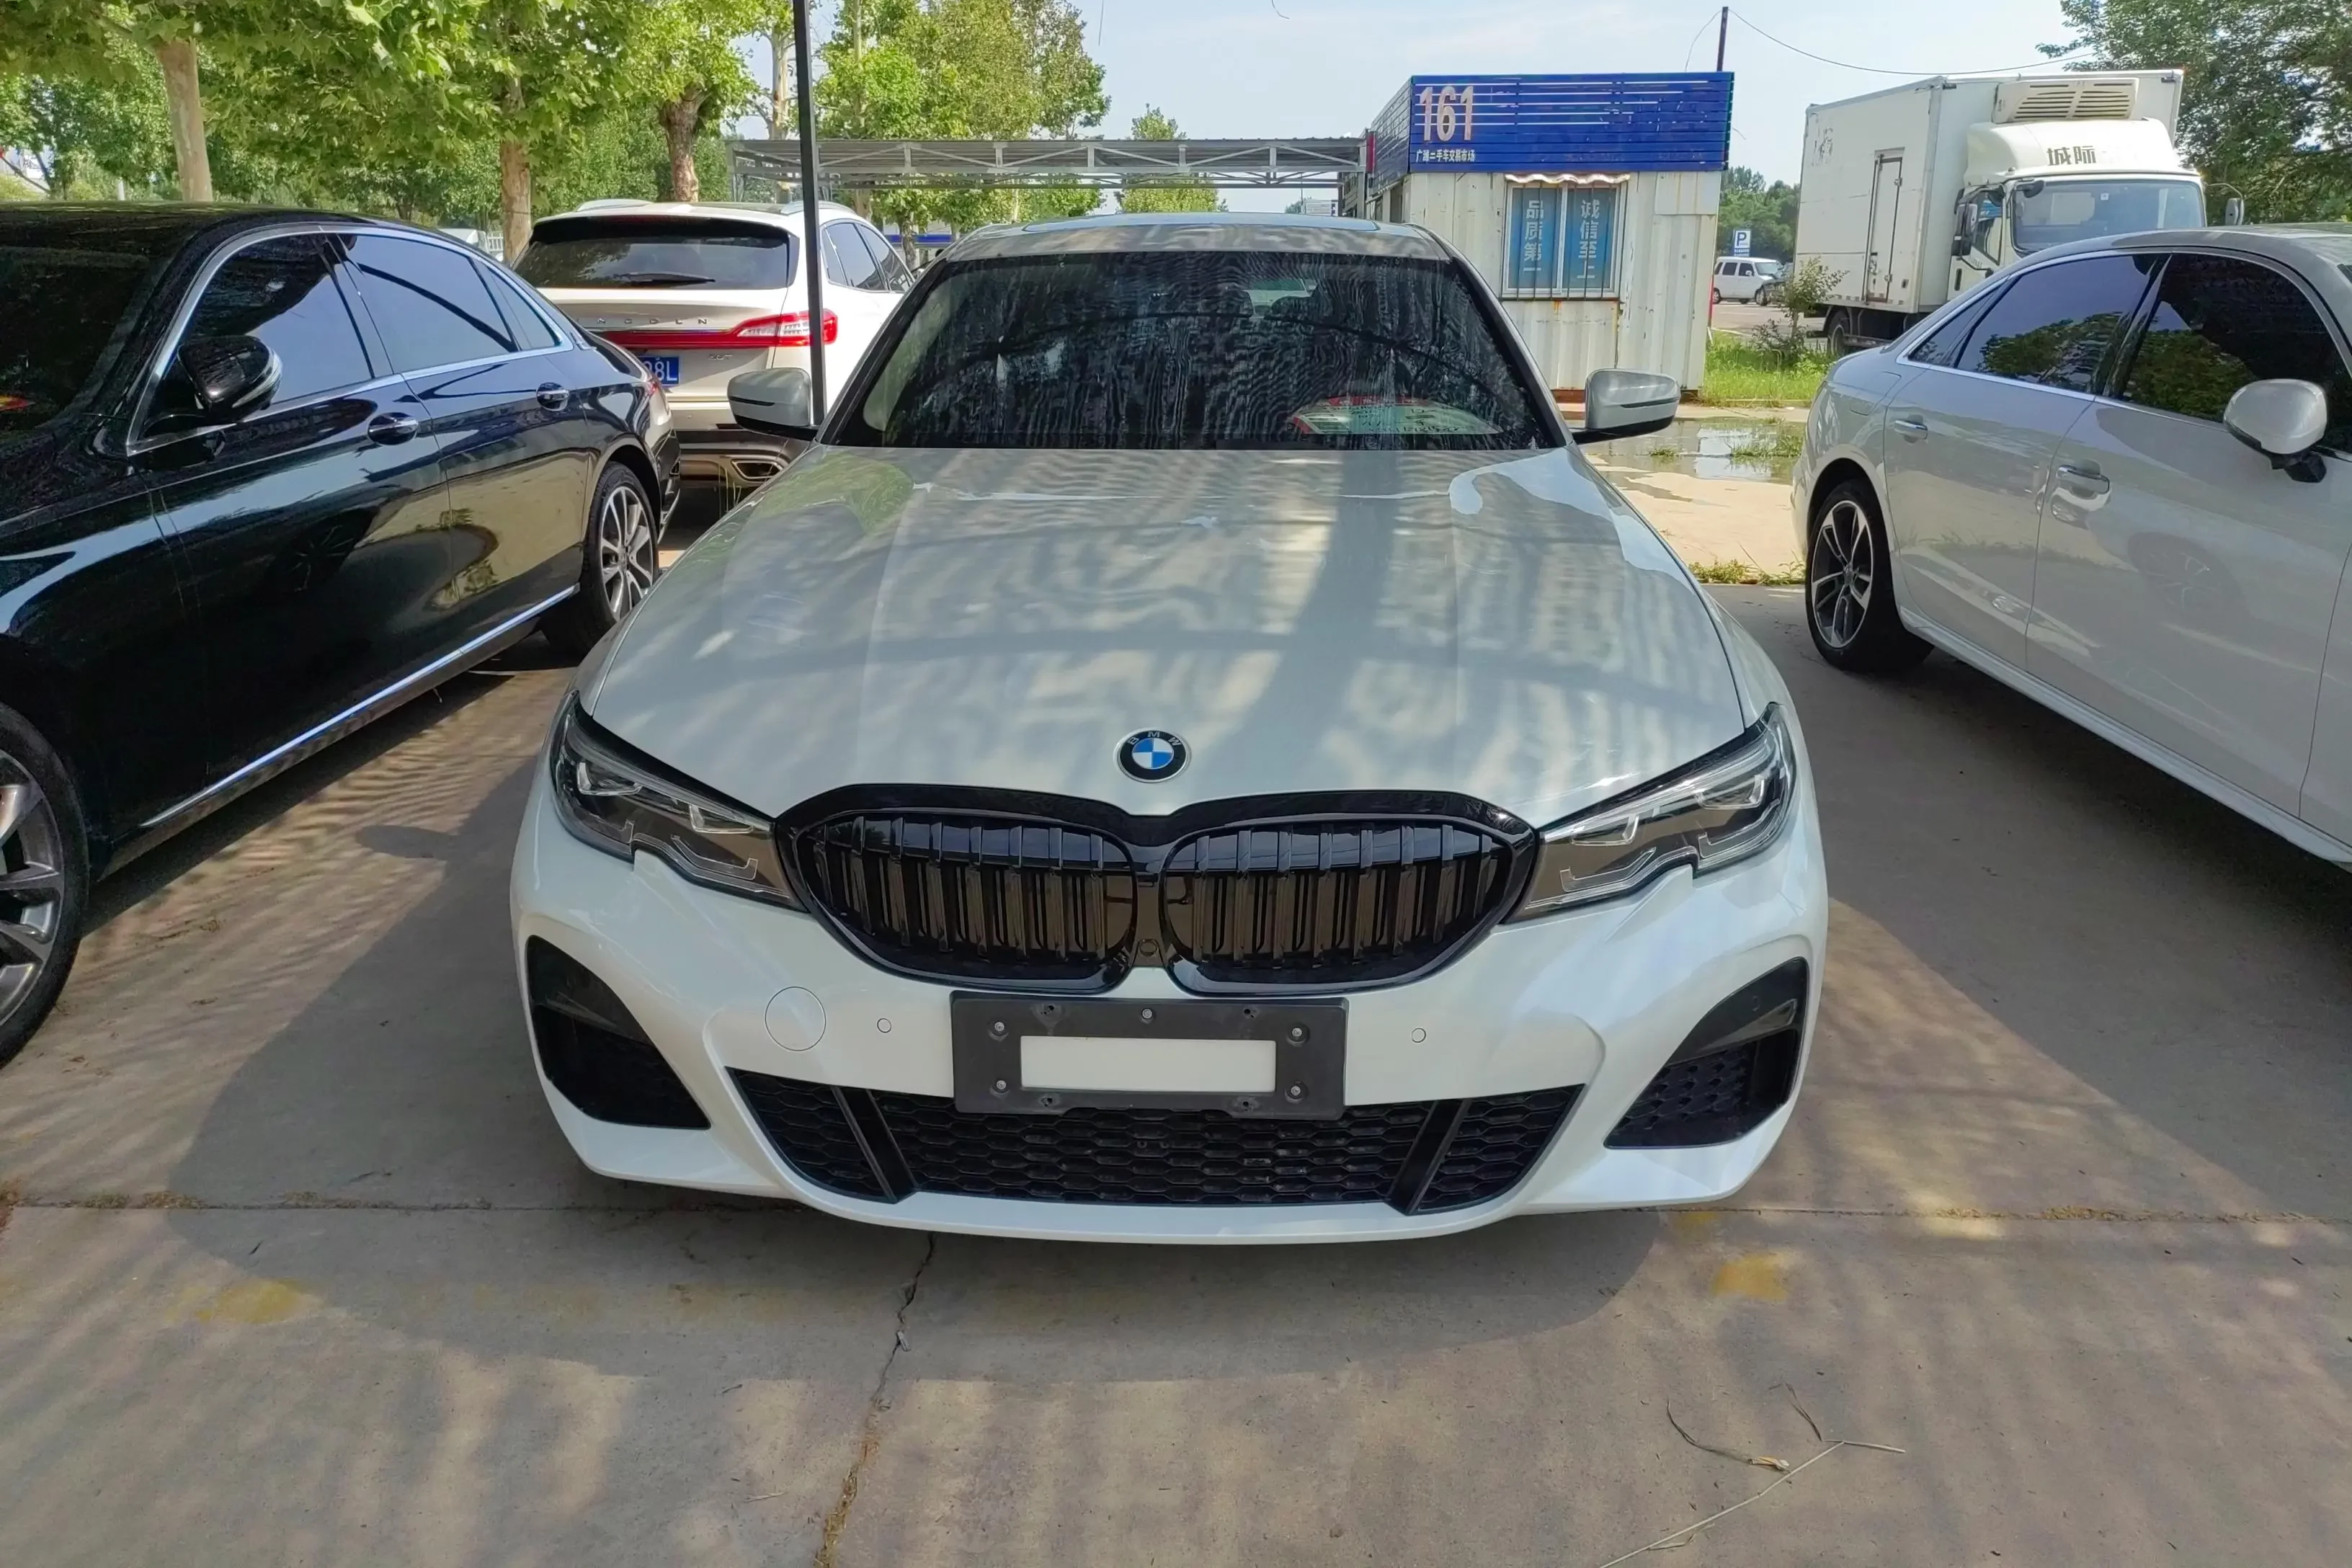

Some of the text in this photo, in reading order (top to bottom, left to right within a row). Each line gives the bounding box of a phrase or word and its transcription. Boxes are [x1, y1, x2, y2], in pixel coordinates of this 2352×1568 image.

[1420, 86, 1474, 141] 161
[2046, 146, 2096, 166] 城际
[1523, 200, 1544, 272] 品质第一
[1577, 199, 1600, 278] 诚信至上
[1737, 232, 1747, 246] P
[1126, 731, 1182, 747] BMW
